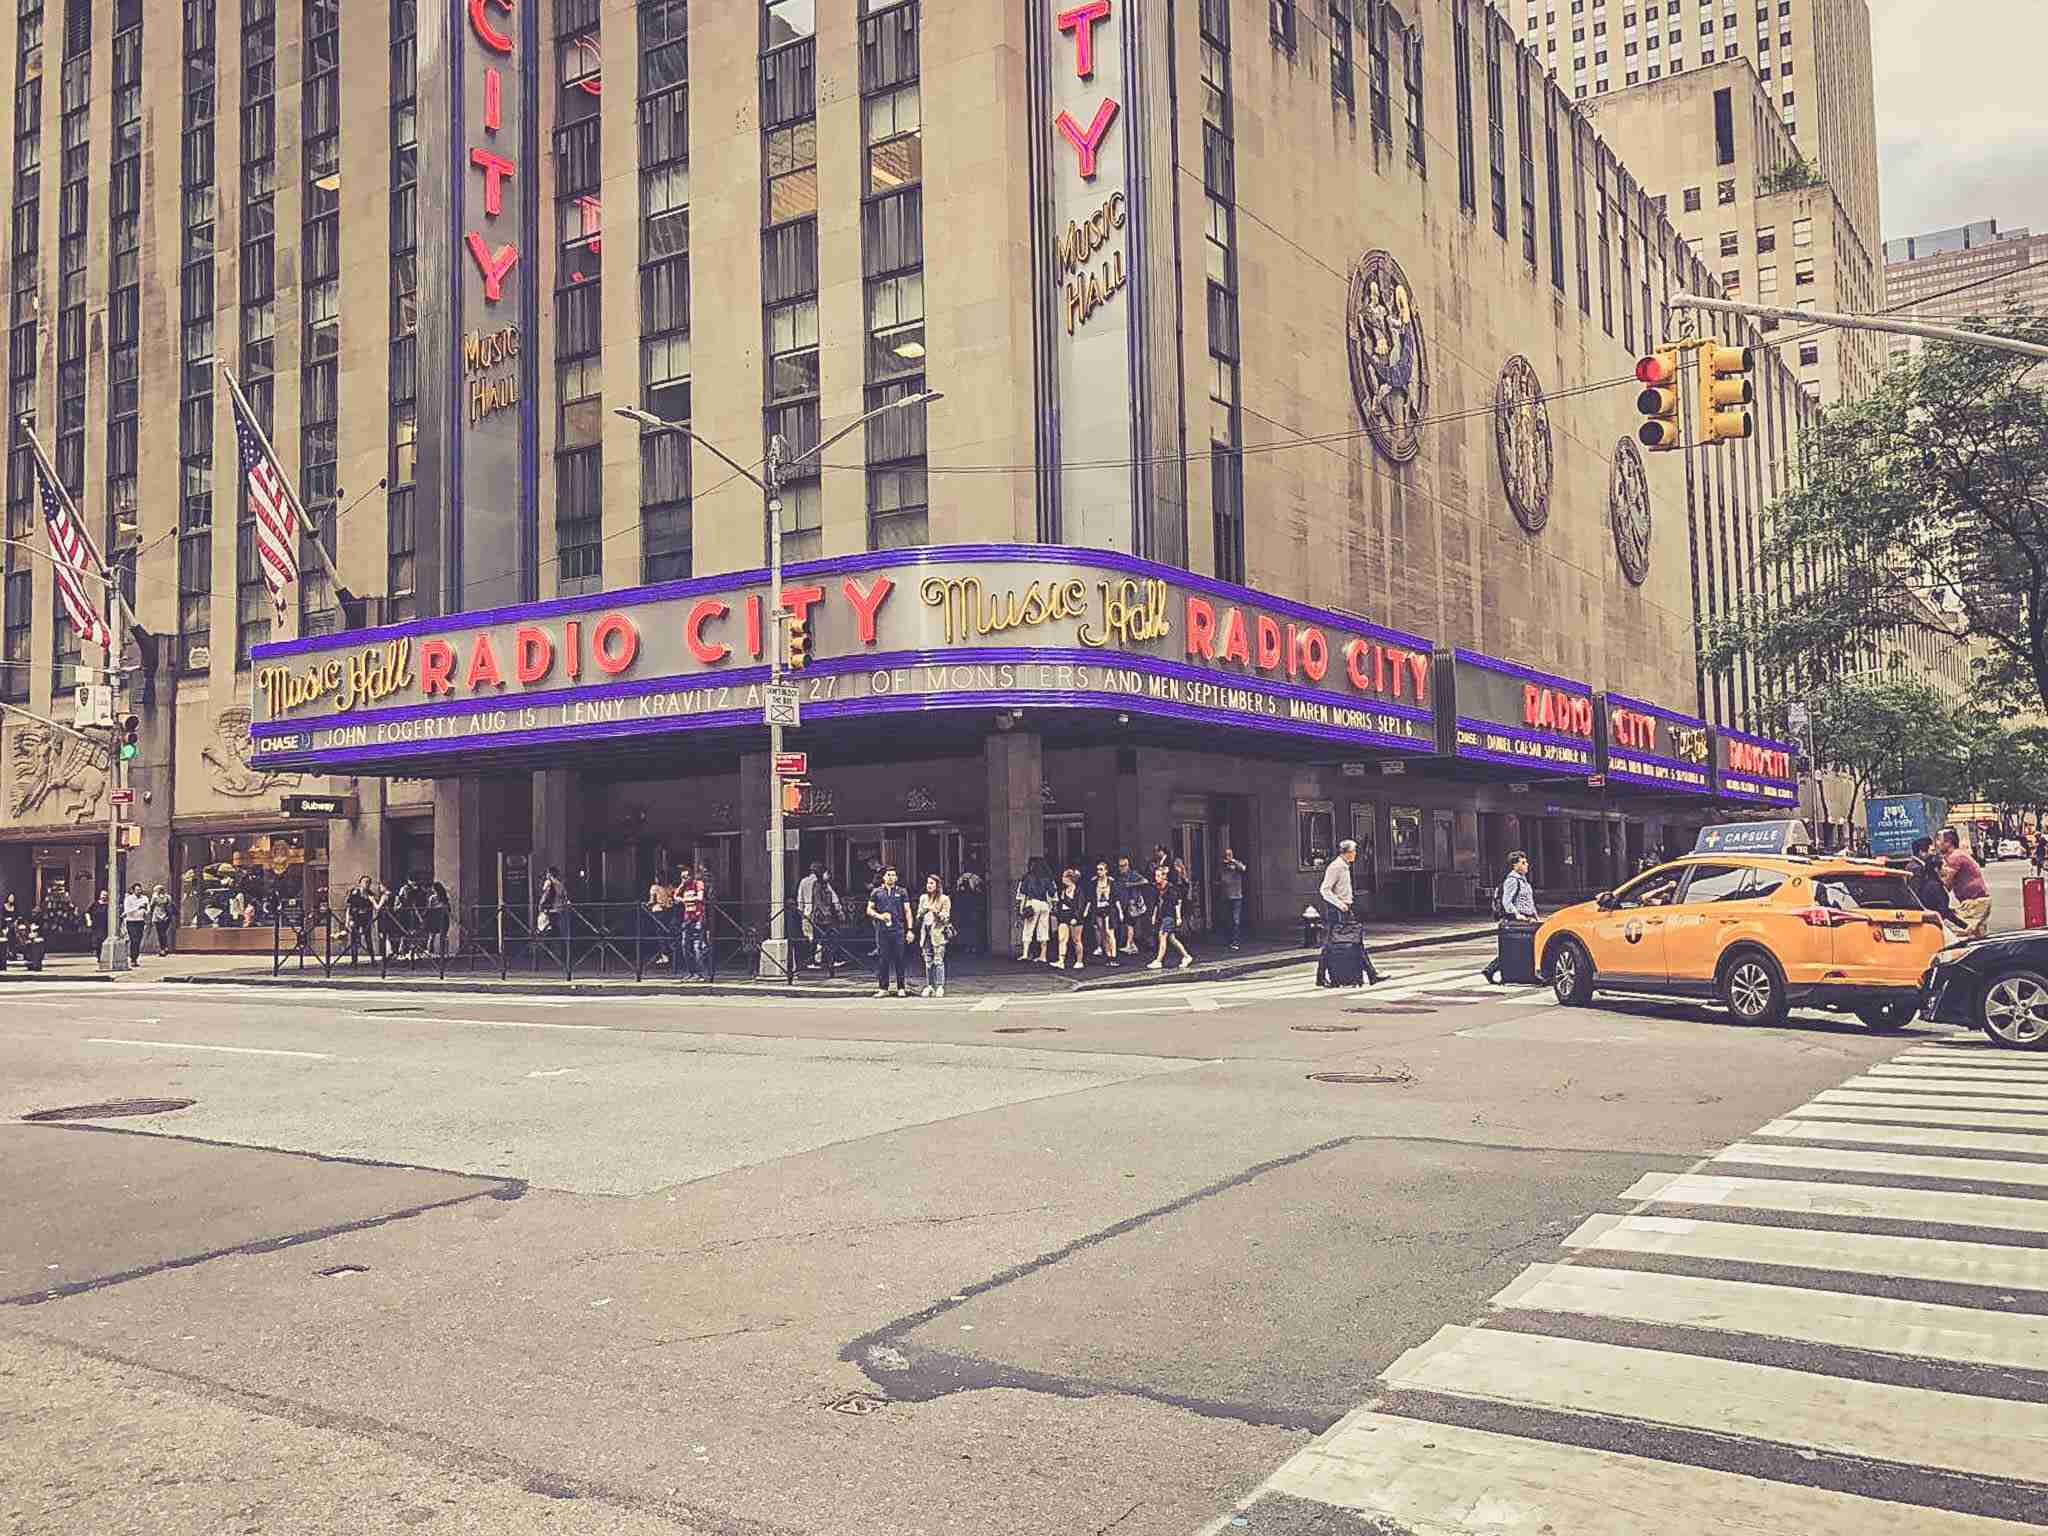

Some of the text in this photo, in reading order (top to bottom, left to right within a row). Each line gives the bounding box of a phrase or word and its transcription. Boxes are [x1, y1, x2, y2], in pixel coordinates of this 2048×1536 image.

[465, 0, 519, 303] CITY
[921, 576, 1170, 647] Music Hall
[420, 575, 896, 697] RADIO CITY
[1185, 595, 1429, 700] RADIO CITY
[259, 636, 414, 717] Music Hall
[809, 675, 837, 699] 27
[871, 664, 1277, 715] OF MONSTERS AND MEN SEPTEMBER 5
[561, 697, 625, 725] LENNY
[639, 687, 730, 716] KRAVITZ
[1290, 699, 1413, 737] MAREN MORRIS SEPT 6
[1524, 683, 1593, 736] RADIO
[261, 734, 299, 752] CHASE
[324, 711, 537, 747] JOHN FOGERTY AUG 15
[1486, 734, 1513, 753] DANIEL
[1515, 739, 1542, 757] CAESAR
[1611, 708, 1657, 750] CITY
[301, 800, 336, 813] Subway
[1723, 829, 1779, 843] CAPSULE
